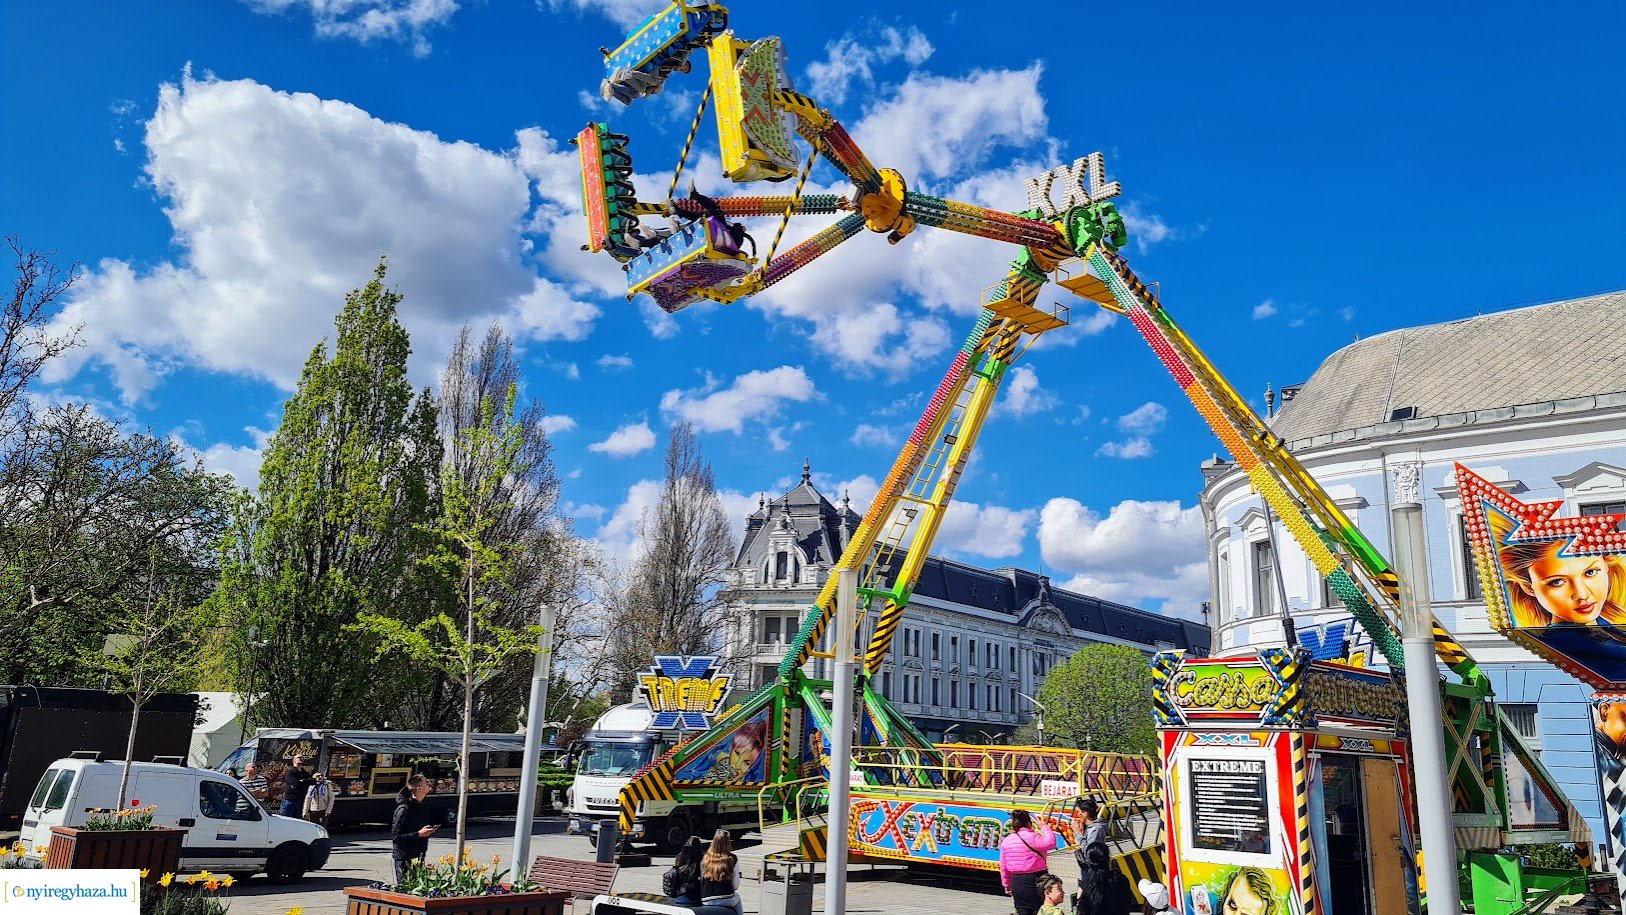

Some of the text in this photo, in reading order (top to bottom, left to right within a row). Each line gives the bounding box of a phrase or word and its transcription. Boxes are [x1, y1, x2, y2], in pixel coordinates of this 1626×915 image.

[1024, 151, 1121, 217] XXL
[1169, 670, 1276, 709] Cassa
[1191, 732, 1260, 747] XXL
[1340, 737, 1374, 752] XXL
[1191, 760, 1262, 774] EXTREME
[592, 797, 617, 805] IVECO
[714, 791, 741, 799] ULTRA
